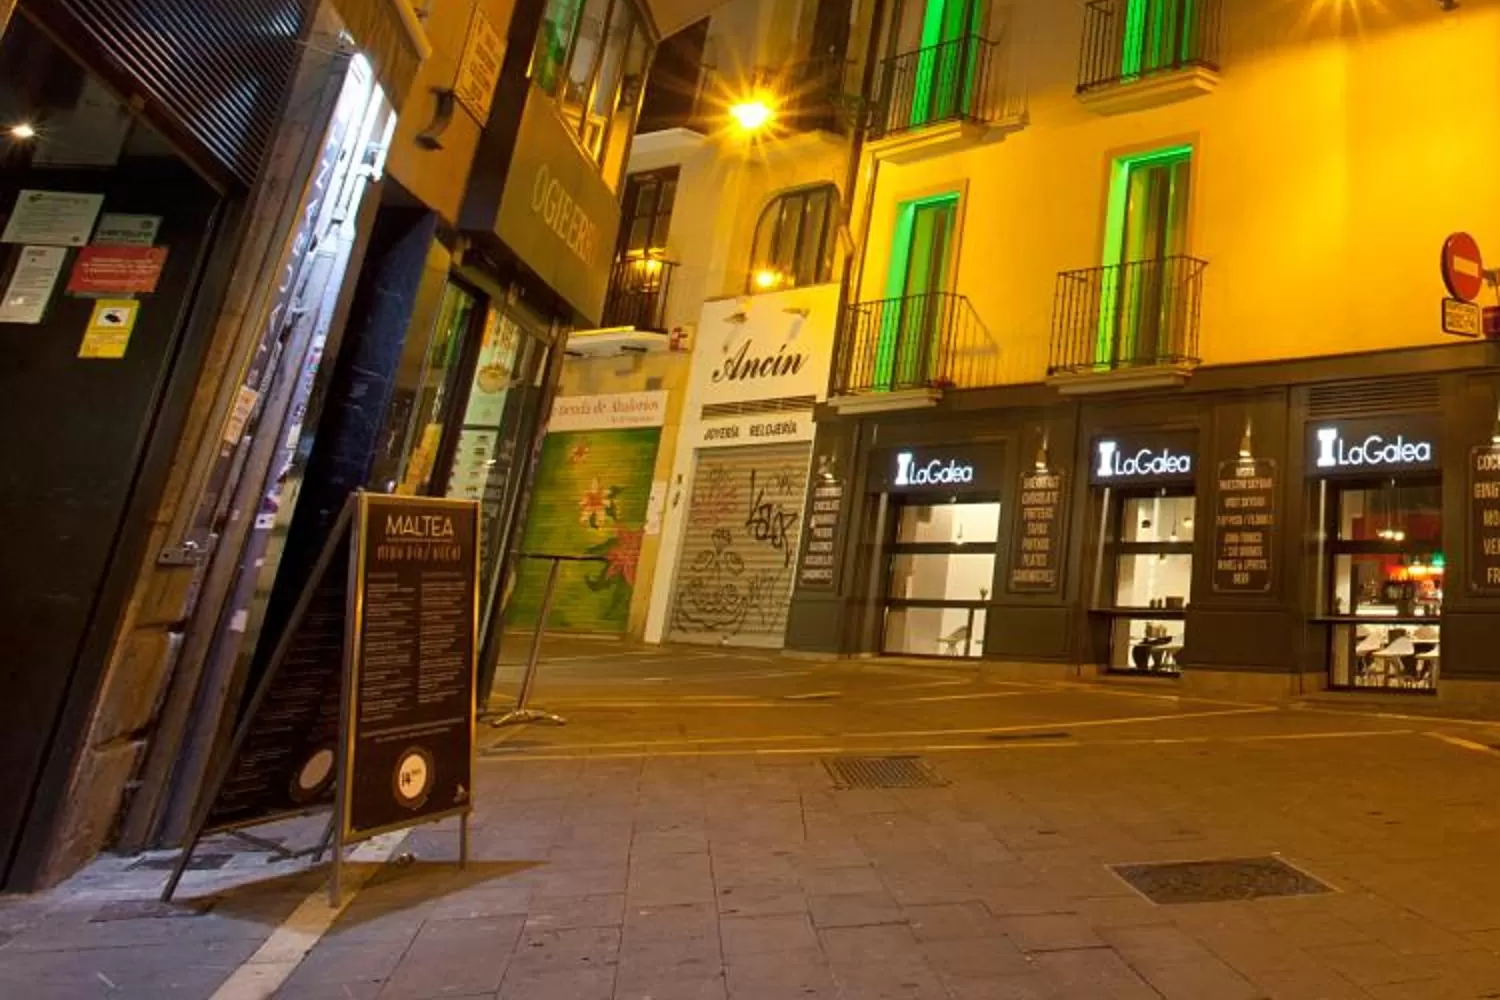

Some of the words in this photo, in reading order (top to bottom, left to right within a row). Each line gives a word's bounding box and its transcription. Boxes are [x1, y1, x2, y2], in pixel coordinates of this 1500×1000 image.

[711, 339, 809, 383] Ancín
[1338, 435, 1431, 465] LaGalea
[386, 515, 455, 537] MALTEA
